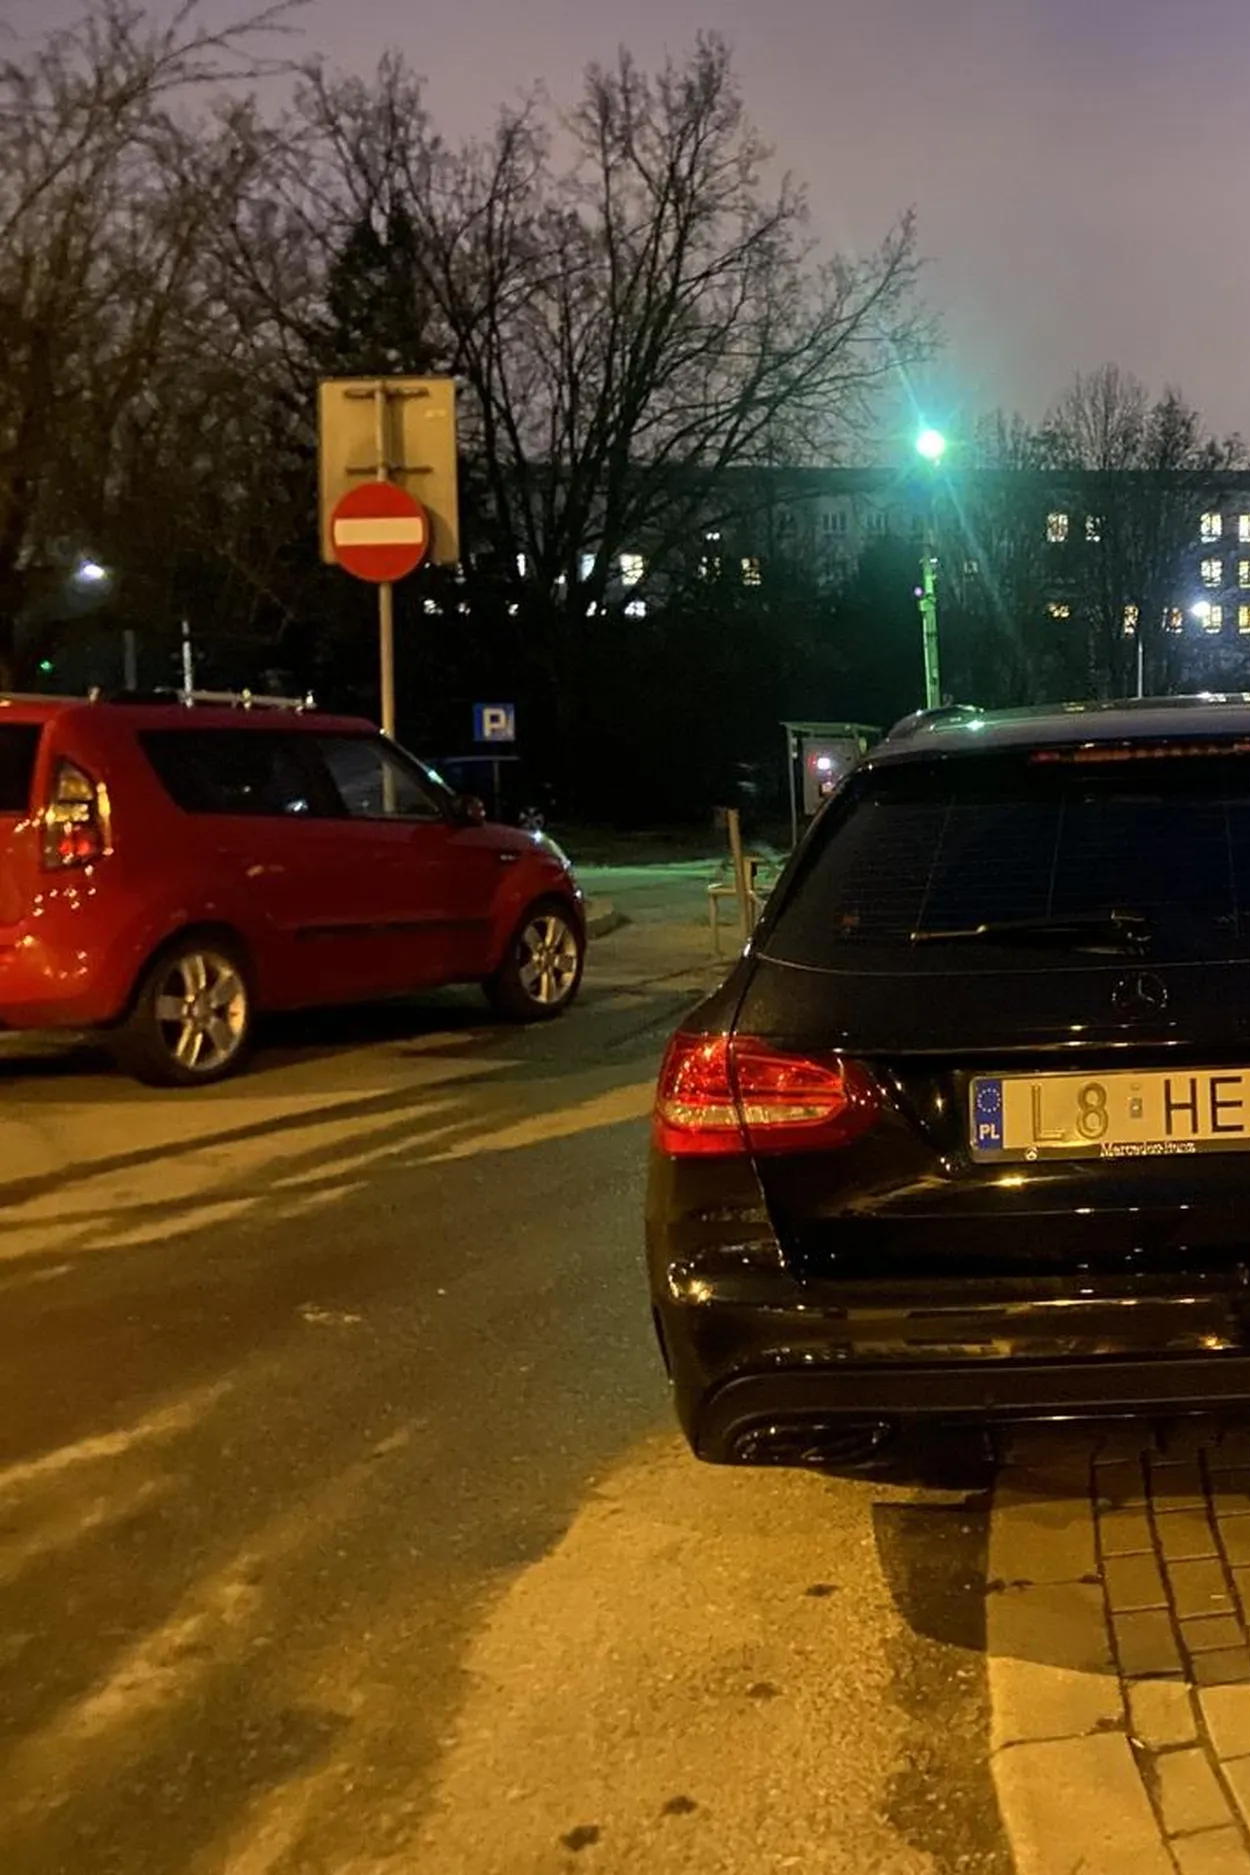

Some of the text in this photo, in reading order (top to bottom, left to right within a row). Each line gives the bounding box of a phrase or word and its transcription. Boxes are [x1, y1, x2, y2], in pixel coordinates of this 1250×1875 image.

[483, 708, 507, 737] P
[1030, 1081, 1109, 1143] L8
[979, 1123, 1000, 1140] PL
